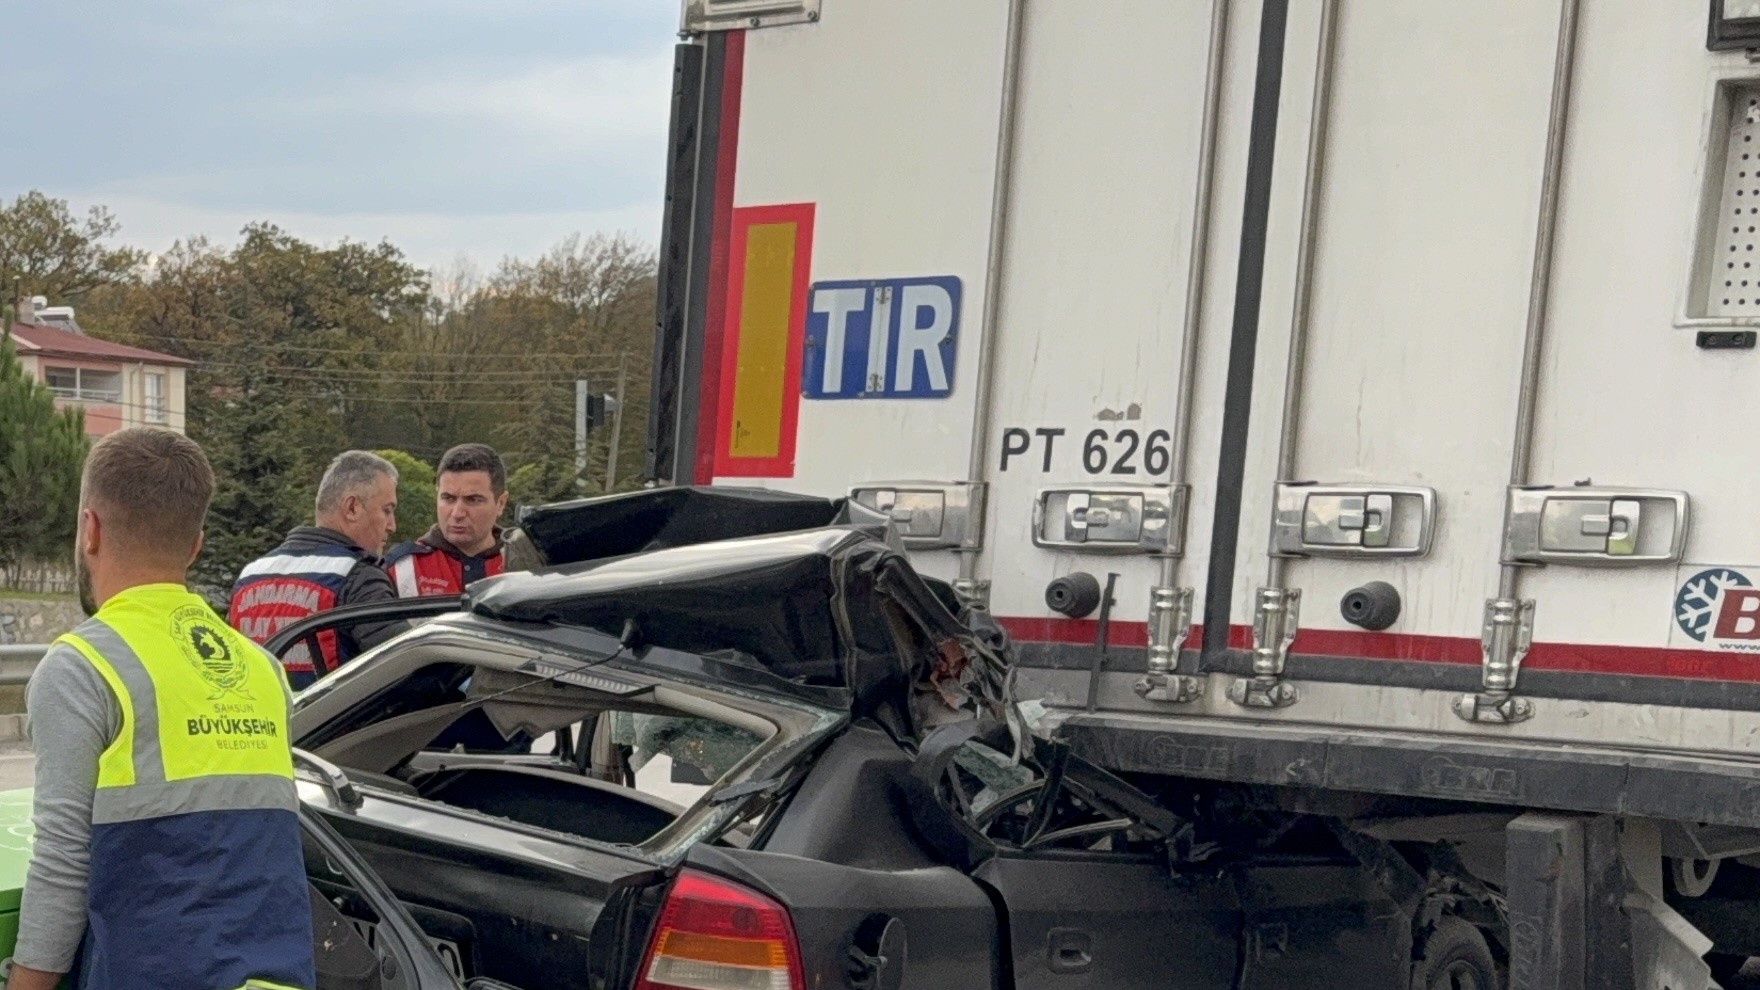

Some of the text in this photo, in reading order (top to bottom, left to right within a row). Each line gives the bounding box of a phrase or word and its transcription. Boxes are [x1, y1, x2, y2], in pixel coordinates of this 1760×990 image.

[813, 284, 953, 393] TIR
[1000, 428, 1171, 475] PT 626
[214, 703, 255, 713] SAMSUN
[187, 714, 278, 738] BÜYÜKŞEHİR
